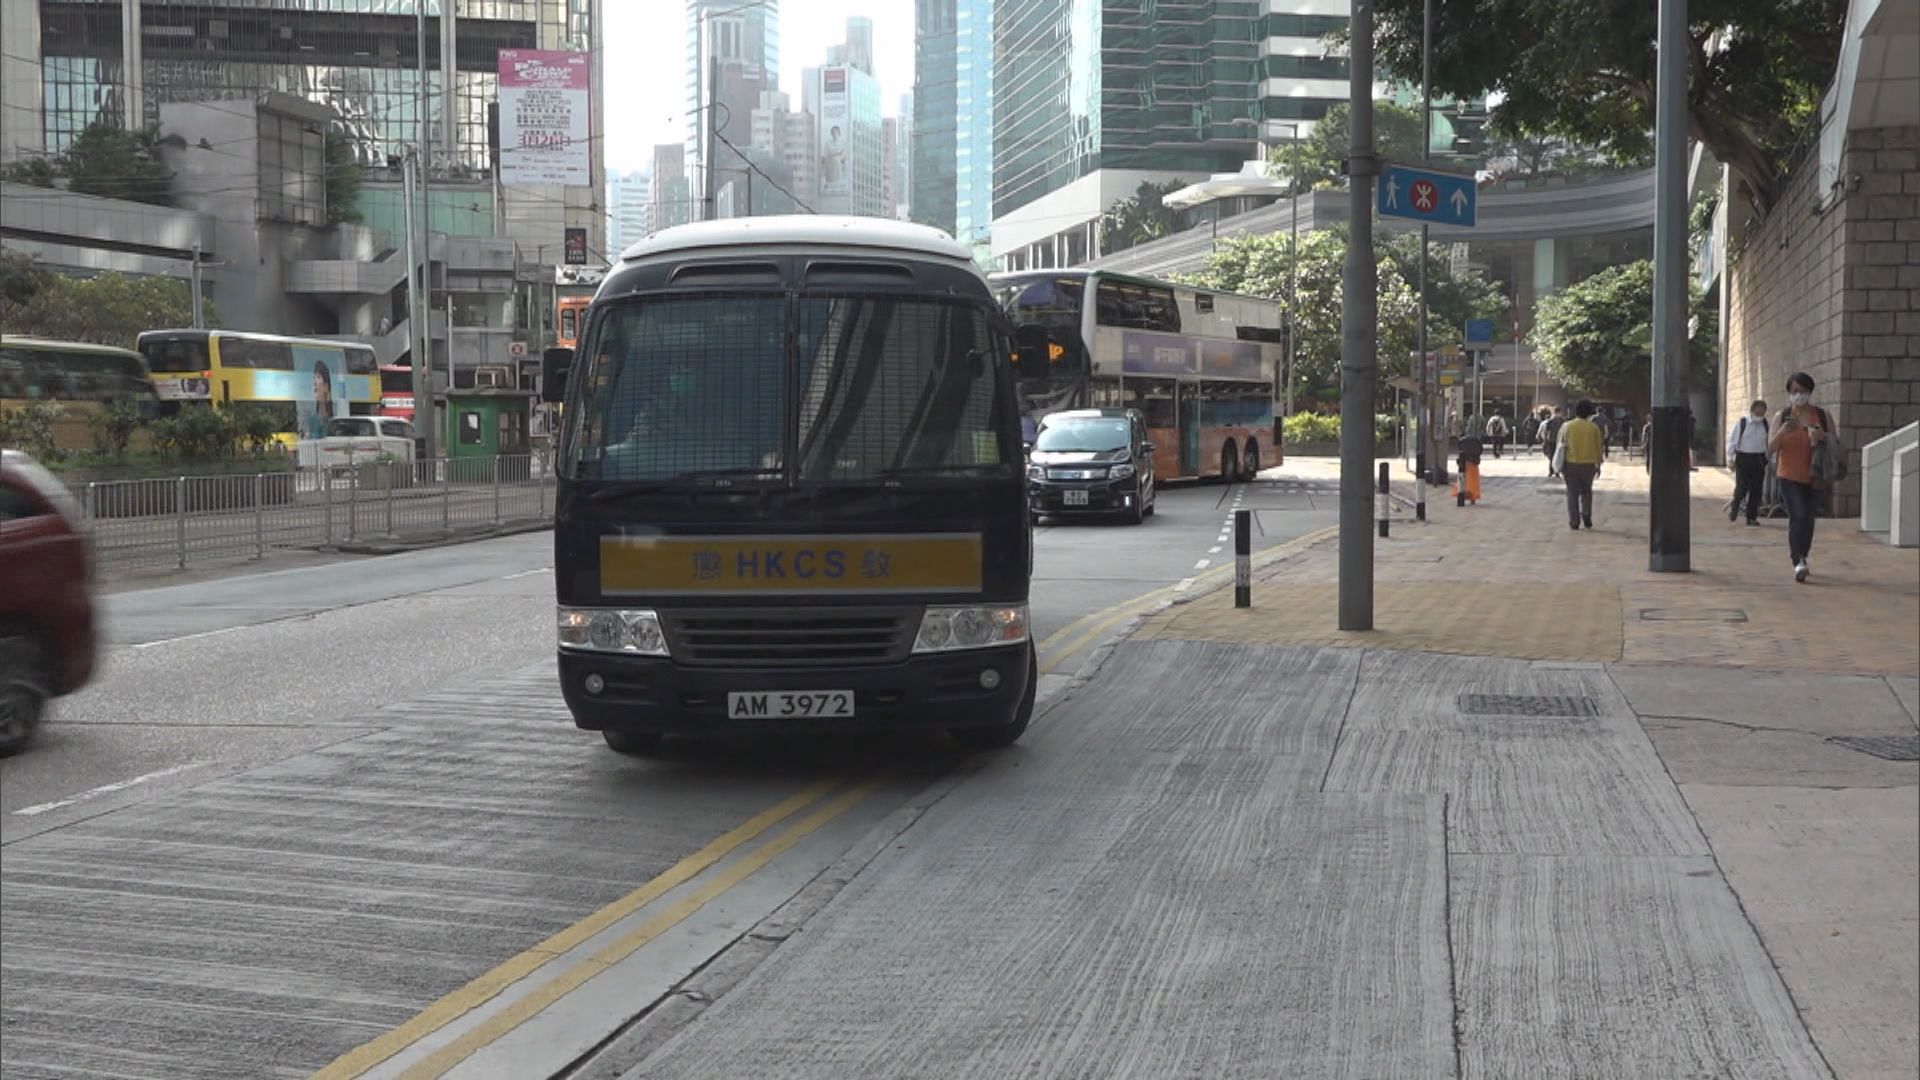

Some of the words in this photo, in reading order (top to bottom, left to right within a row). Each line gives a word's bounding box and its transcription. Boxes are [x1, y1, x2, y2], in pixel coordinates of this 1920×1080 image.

[735, 549, 846, 579] HKCS
[734, 694, 768, 715] AM
[779, 693, 850, 715] 3972
